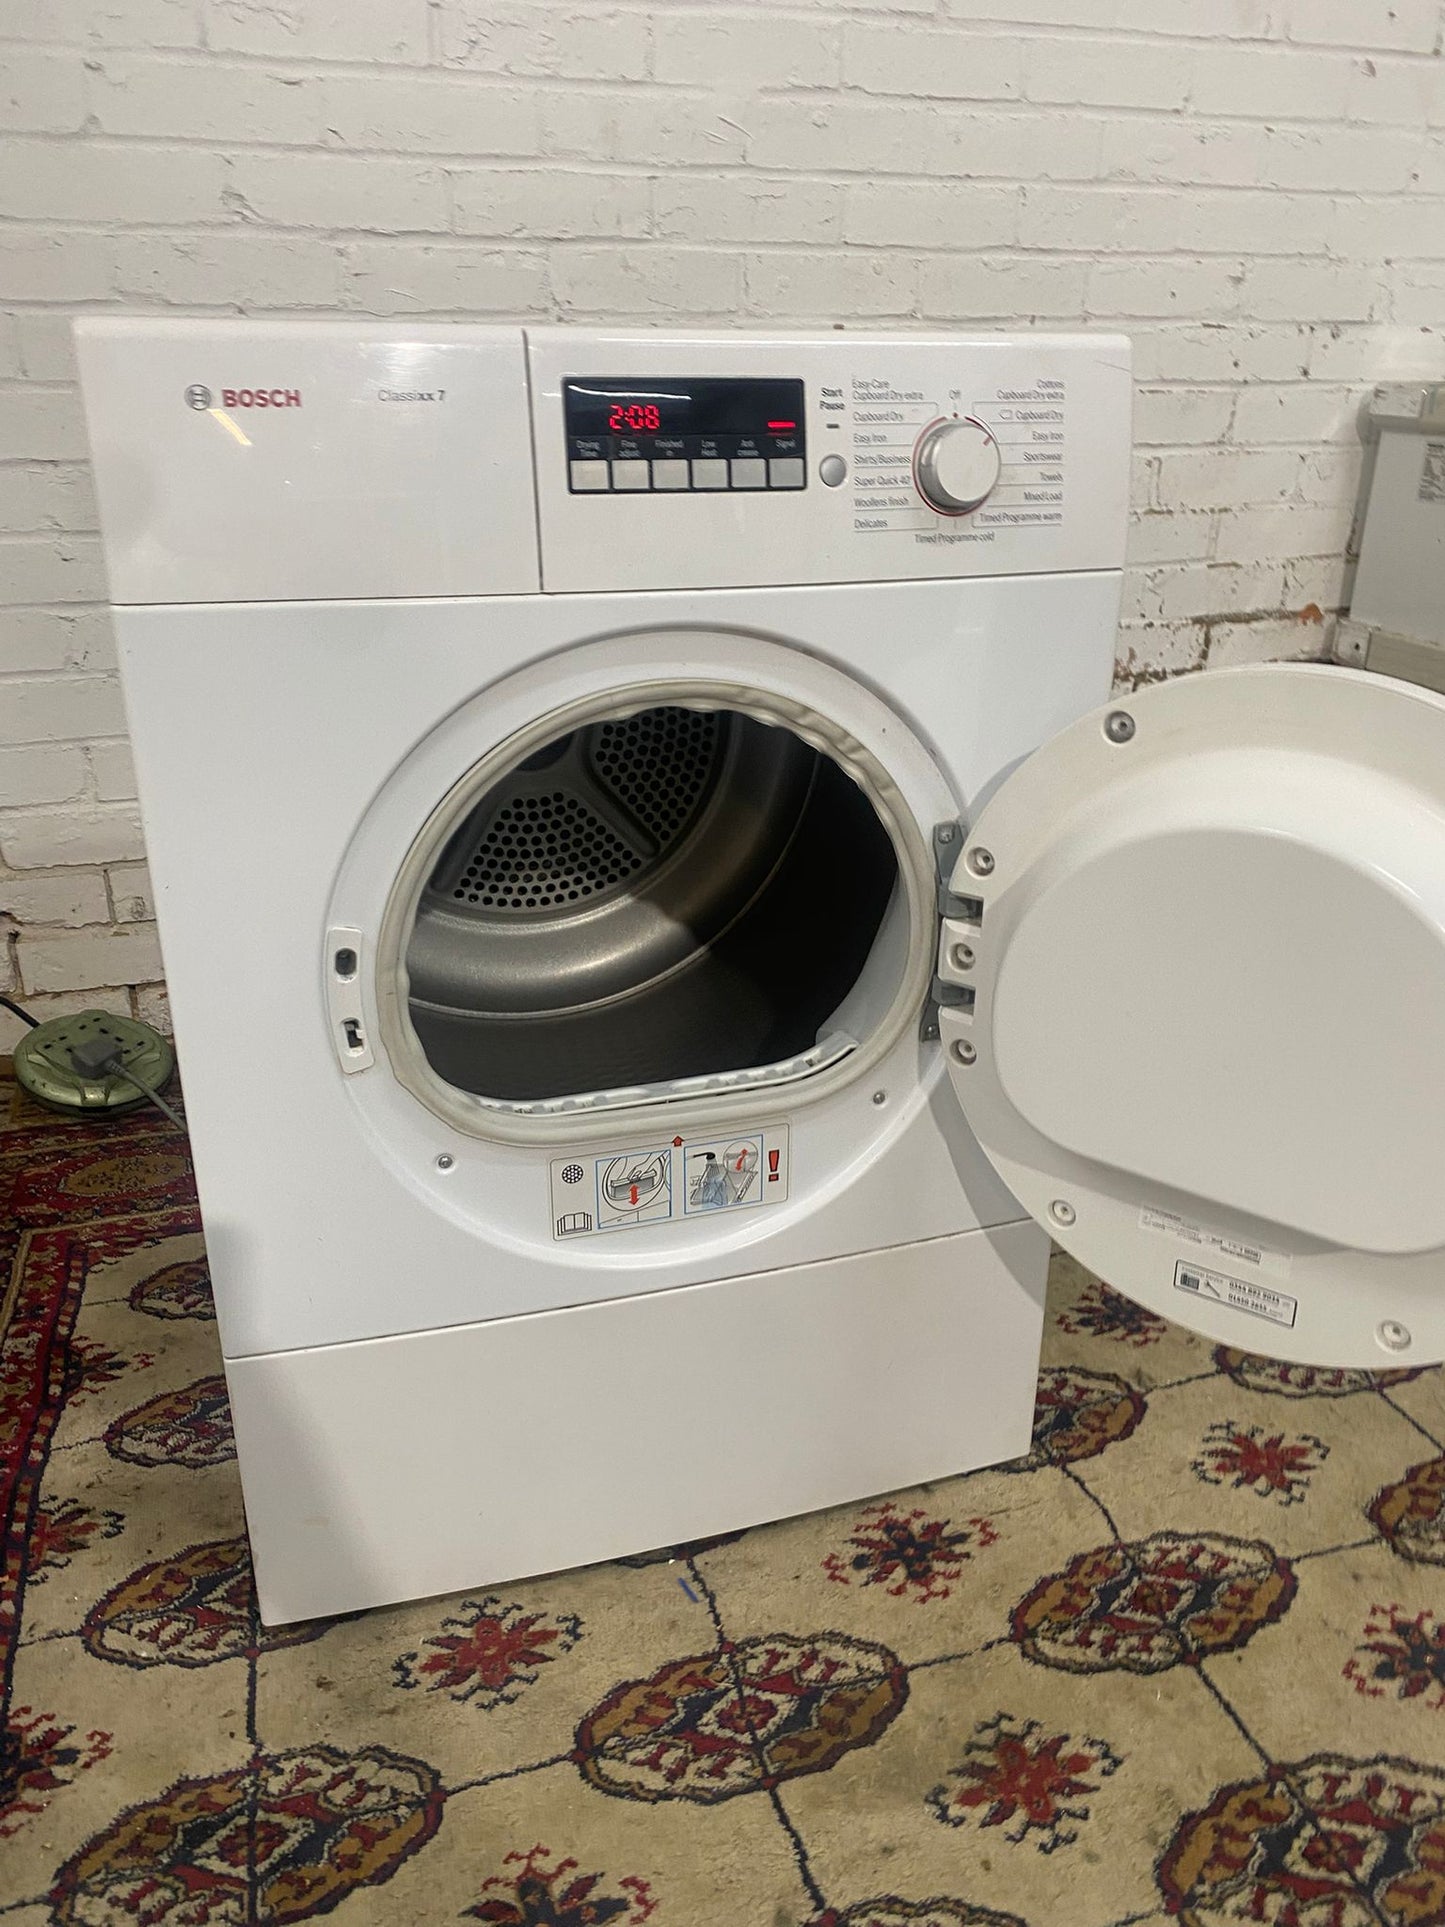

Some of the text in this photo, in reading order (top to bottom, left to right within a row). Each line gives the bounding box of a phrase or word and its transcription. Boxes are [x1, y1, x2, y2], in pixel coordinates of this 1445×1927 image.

[221, 388, 302, 408] BOSCH
[377, 389, 446, 402] Classixx 7
[821, 387, 845, 398] Start
[853, 390, 923, 401] Cupboard Dry extra
[949, 389, 961, 400] Off
[996, 389, 1065, 401] Cupboard Dry extra
[820, 400, 846, 411] Pause
[609, 403, 660, 430] 2:08
[853, 411, 904, 422] Cupboard Dry
[1016, 410, 1064, 421] Cupboard Dry
[853, 433, 888, 444] Easy Iron
[1032, 431, 1064, 442] Easy Iron
[655, 439, 684, 449] Finished
[854, 454, 911, 466] Shirts/Business
[1023, 451, 1063, 463] Sportswear
[854, 475, 876, 487] Super
[877, 475, 900, 485] Quick
[1040, 471, 1063, 482] Towels
[854, 497, 888, 508] Woollens
[980, 511, 1063, 524] Timed Programme warm
[854, 519, 888, 530] Delicates
[915, 531, 995, 545] Timed Programme cold
